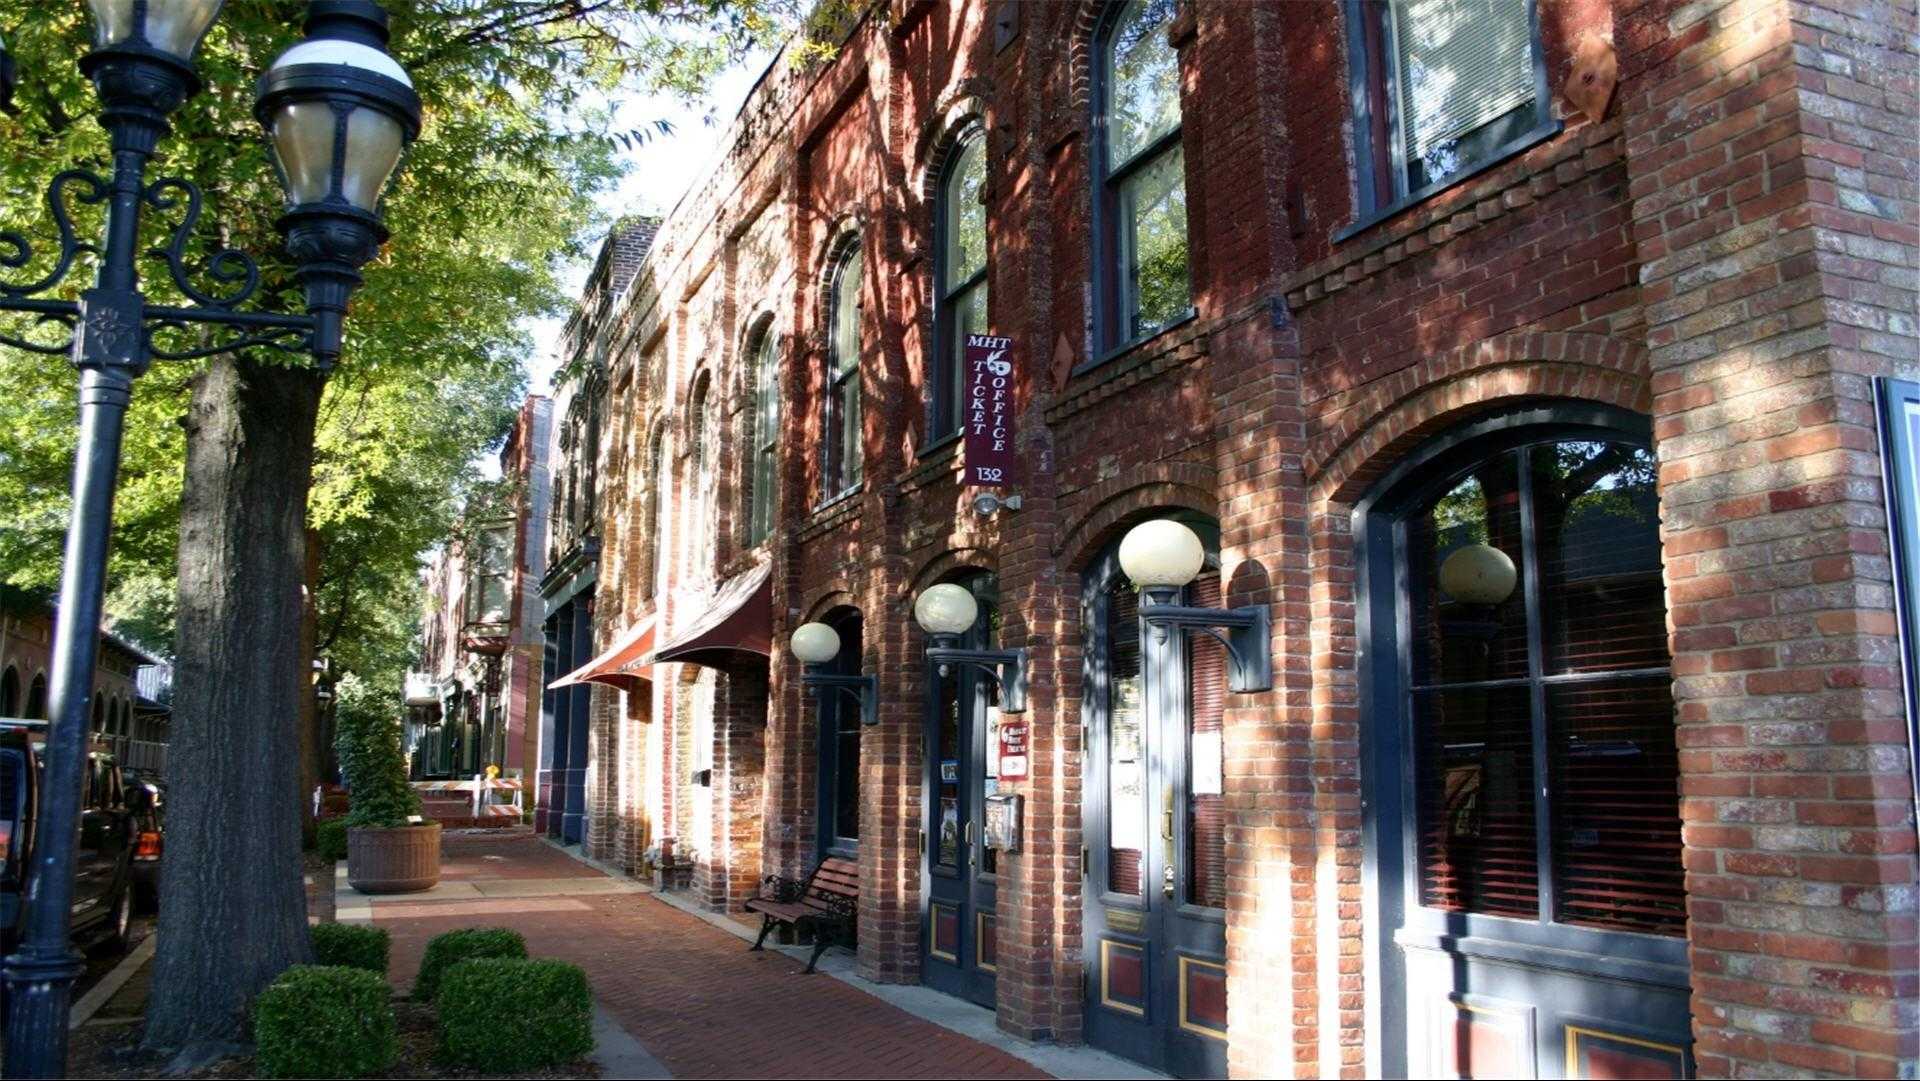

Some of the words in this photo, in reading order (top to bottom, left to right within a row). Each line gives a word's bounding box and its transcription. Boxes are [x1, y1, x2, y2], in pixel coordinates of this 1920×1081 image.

[968, 335, 1011, 349] MHT
[971, 360, 986, 435] TICKET
[992, 377, 1006, 451] OFFICE
[976, 467, 1003, 482] 132
